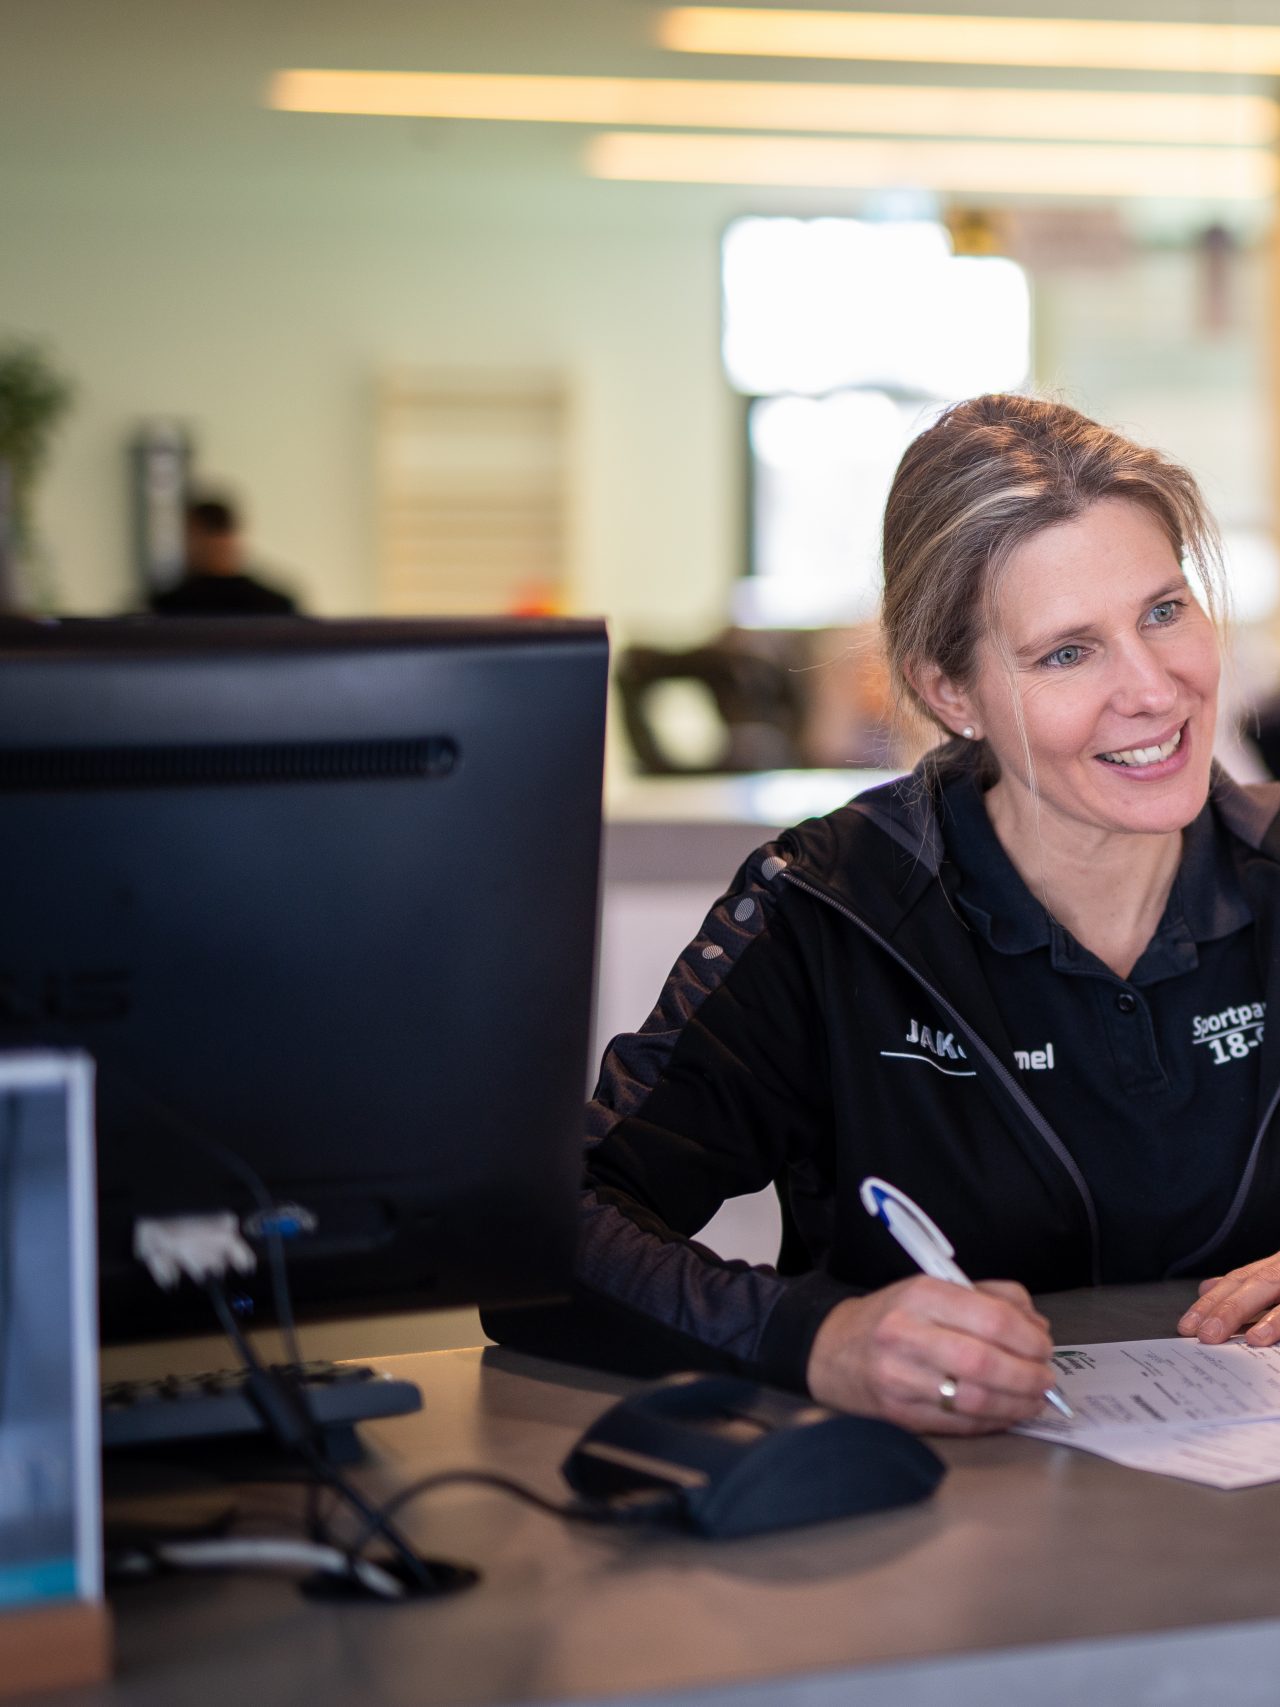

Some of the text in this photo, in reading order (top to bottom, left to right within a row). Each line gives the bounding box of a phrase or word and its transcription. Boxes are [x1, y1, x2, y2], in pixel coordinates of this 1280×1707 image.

[1192, 1002, 1266, 1038] Sportpa
[906, 1018, 967, 1060] JAK
[1013, 1042, 1054, 1070] mel
